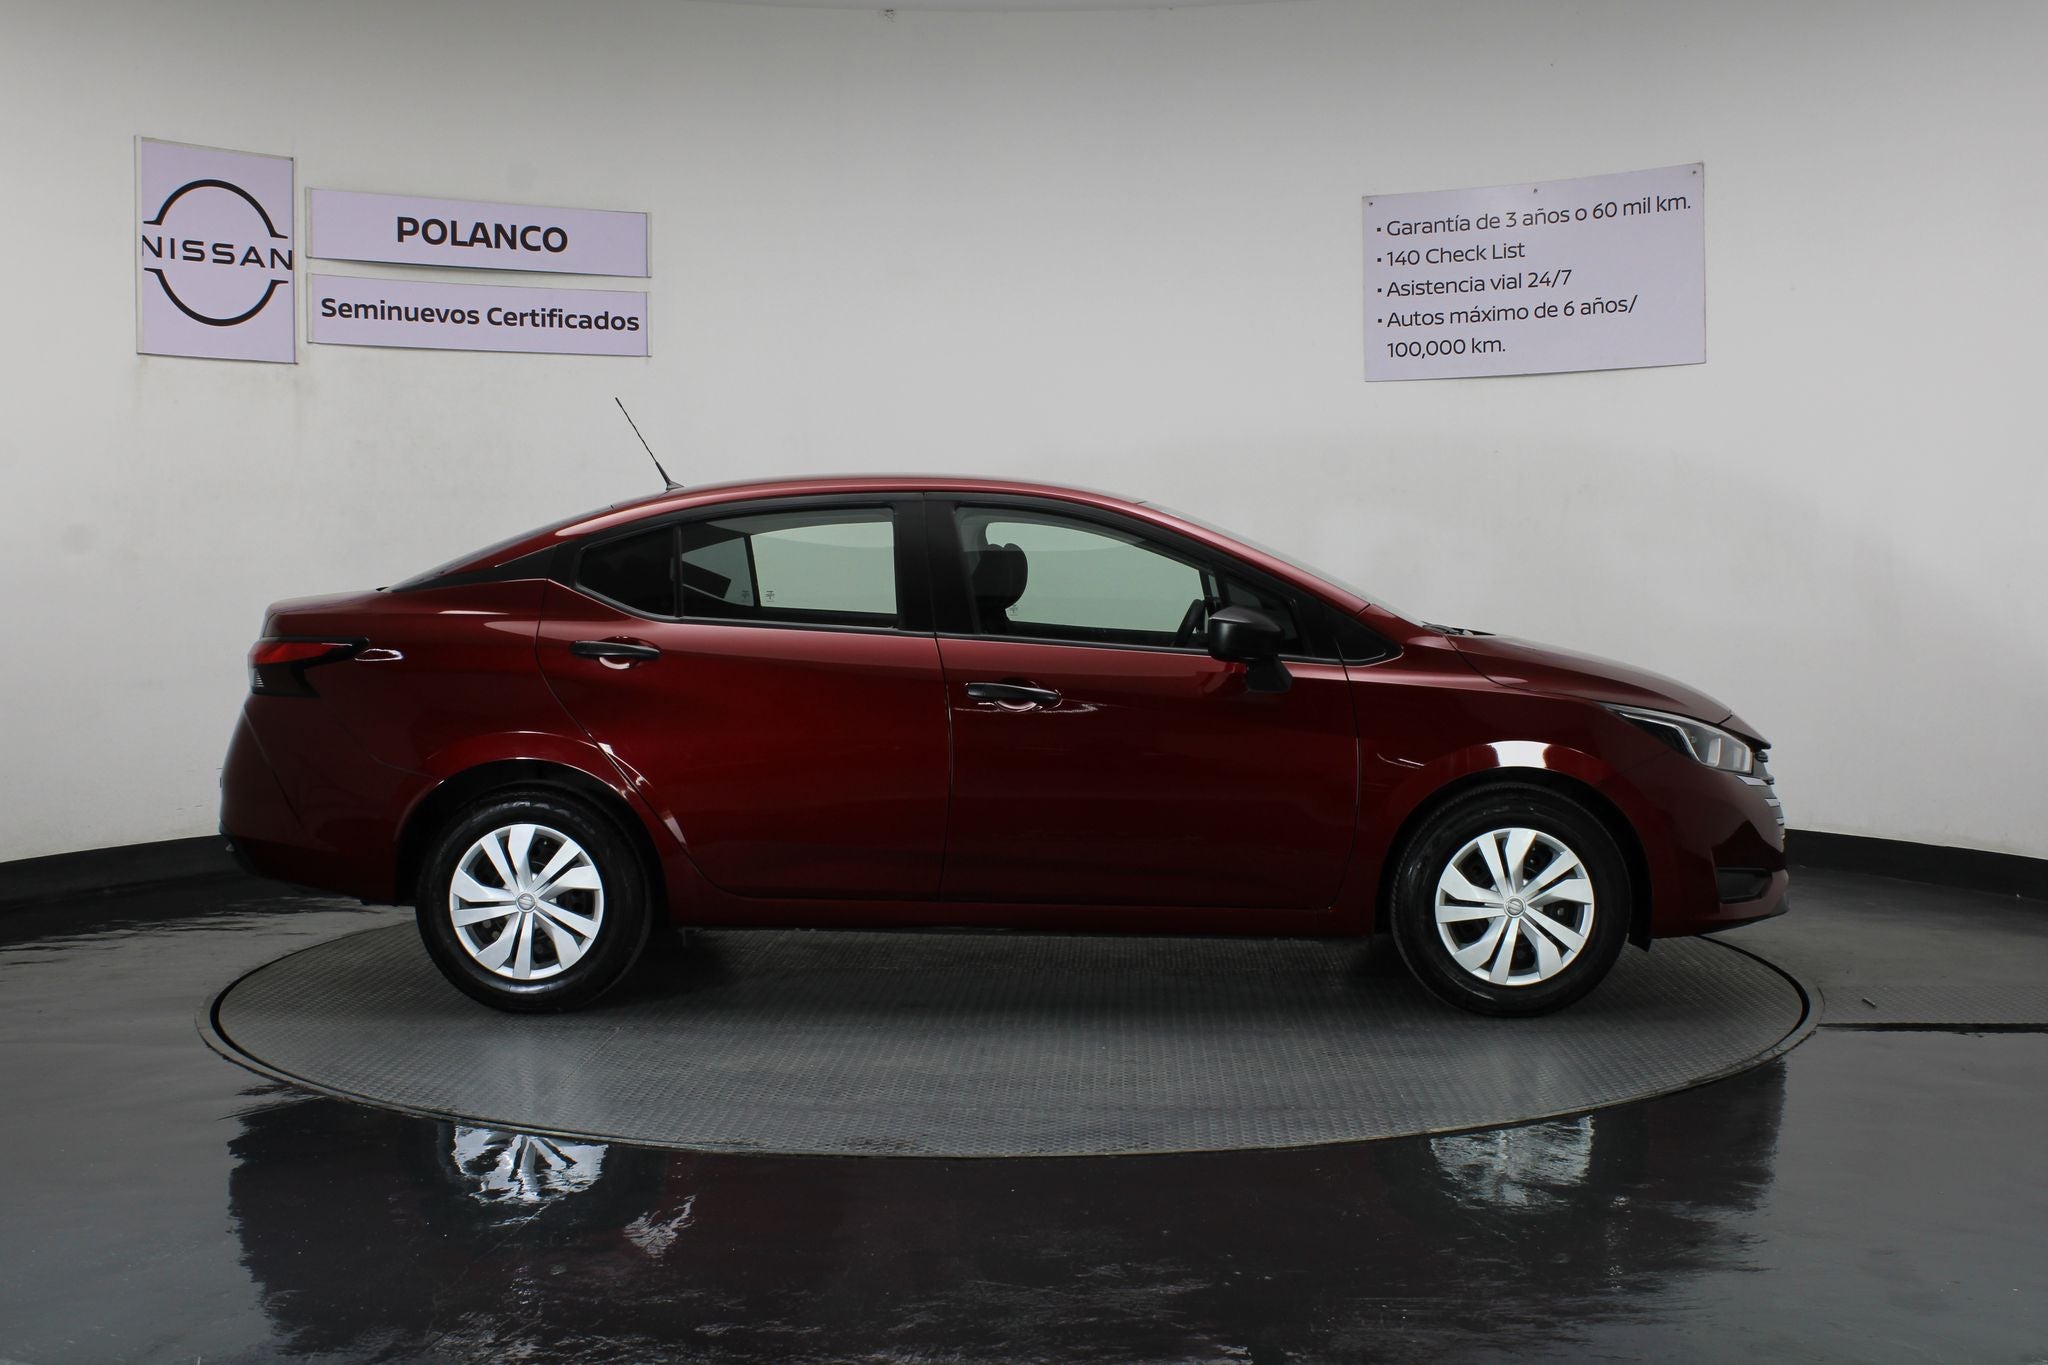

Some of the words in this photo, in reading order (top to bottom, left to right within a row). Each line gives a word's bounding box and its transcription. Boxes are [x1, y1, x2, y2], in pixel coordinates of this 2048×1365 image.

[1387, 215, 1470, 236] Garantía
[1476, 213, 1500, 229] de
[1506, 212, 1516, 227] 3
[1523, 208, 1570, 226] años
[1575, 208, 1587, 221] o
[1593, 202, 1617, 219] 60
[1624, 197, 1650, 216] mil
[1657, 196, 1690, 212] km.
[397, 216, 568, 253] POLANCO
[142, 234, 293, 271] NISSAN
[1387, 250, 1420, 266] 140
[1426, 245, 1487, 264] Check
[1493, 243, 1525, 259] List
[1387, 276, 1485, 297] Asistencia
[1490, 273, 1521, 290] vial
[1528, 269, 1572, 288] 24/7
[322, 298, 479, 325] Seminuevos
[487, 307, 639, 331] Certificados
[1387, 311, 1444, 327] Autos
[1450, 306, 1528, 324] máximo
[1534, 302, 1558, 318] de
[1564, 301, 1574, 316] 6
[1581, 295, 1638, 315] años/
[1387, 339, 1465, 359] 100,000
[1472, 338, 1505, 353] km.
